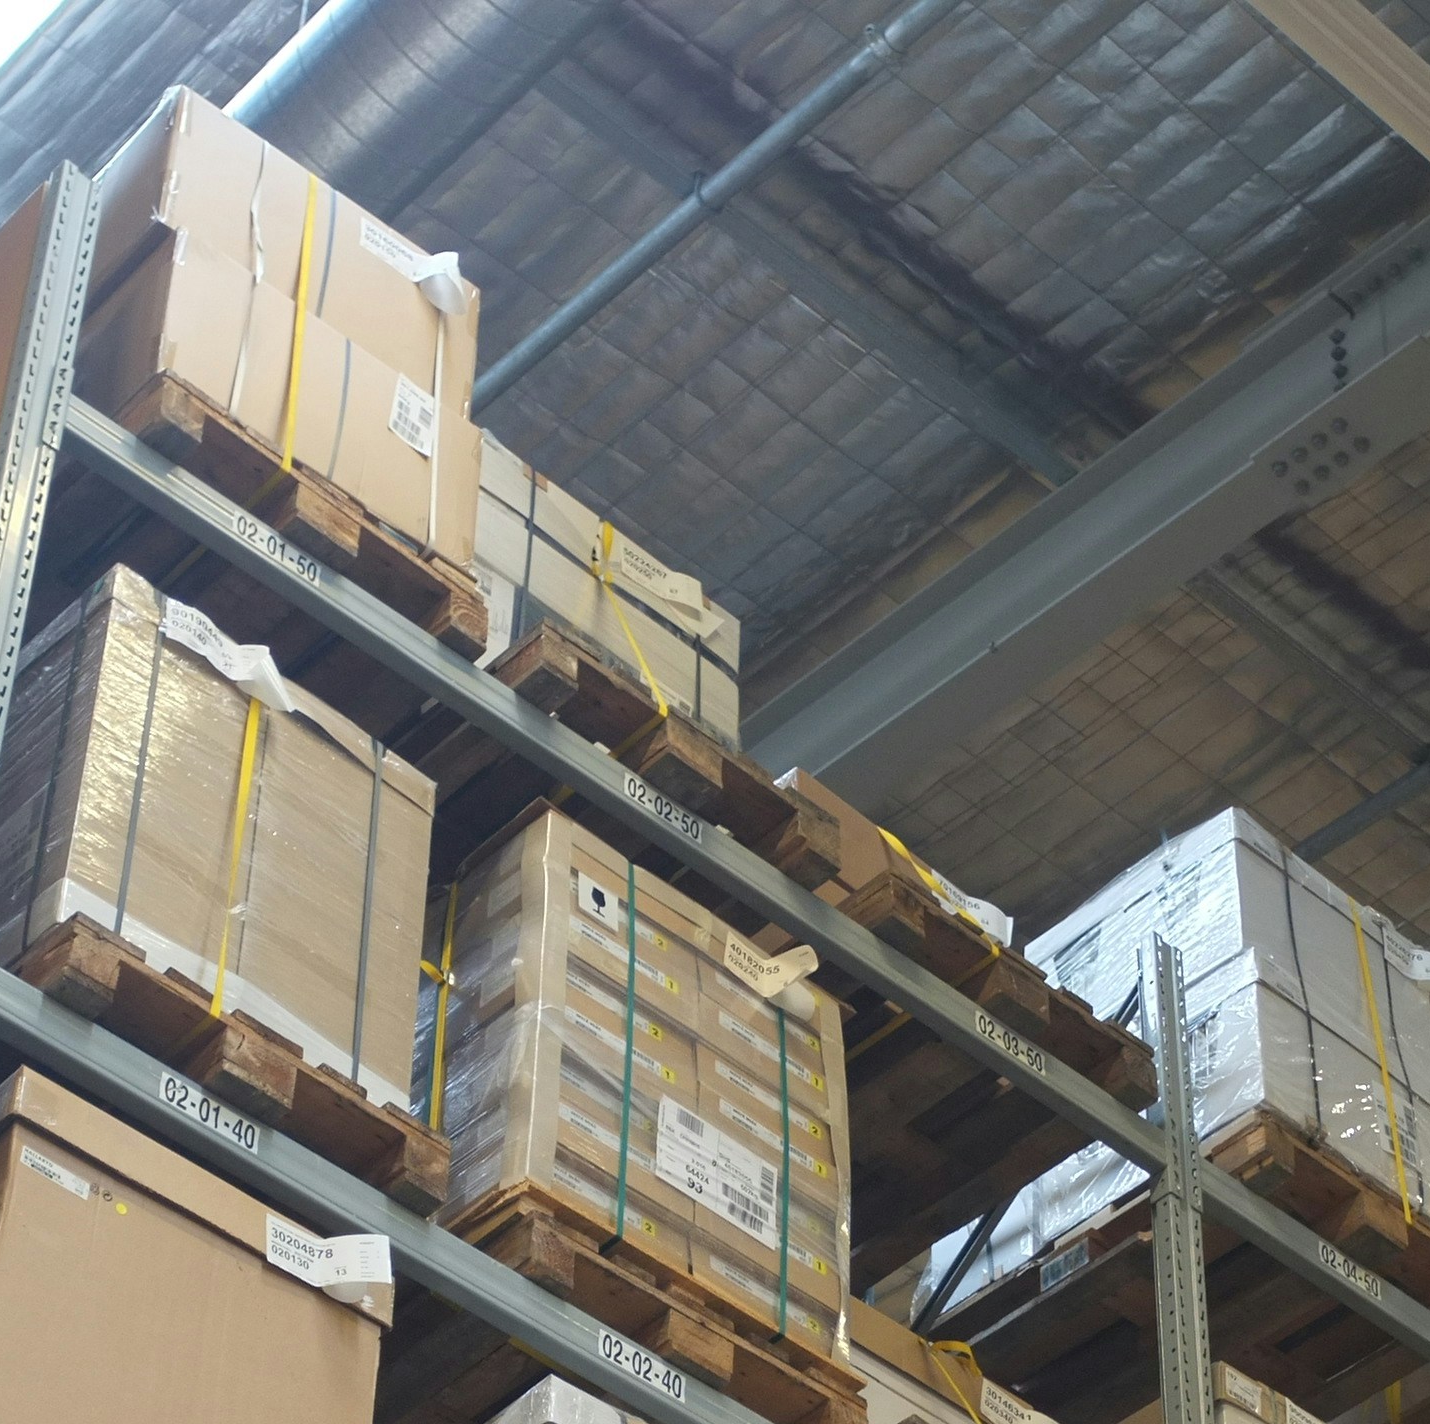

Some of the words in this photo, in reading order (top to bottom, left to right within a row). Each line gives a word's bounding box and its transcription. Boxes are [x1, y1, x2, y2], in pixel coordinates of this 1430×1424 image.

[237, 516, 317, 582] 02-01-50
[172, 619, 207, 646] 020140
[628, 778, 699, 839] 02-02-50
[730, 943, 780, 975] 40182055
[978, 1014, 1043, 1072] 02-03-50
[165, 1077, 255, 1150] 02-01-40
[686, 1177, 703, 1195] 93
[271, 1227, 333, 1260] 30204878
[271, 1243, 310, 1270] 020130
[335, 1268, 347, 1276] 13
[1321, 1244, 1379, 1298] 02-04-50
[603, 1334, 682, 1399] 02-02-40
[984, 1399, 1013, 1424] 020340
